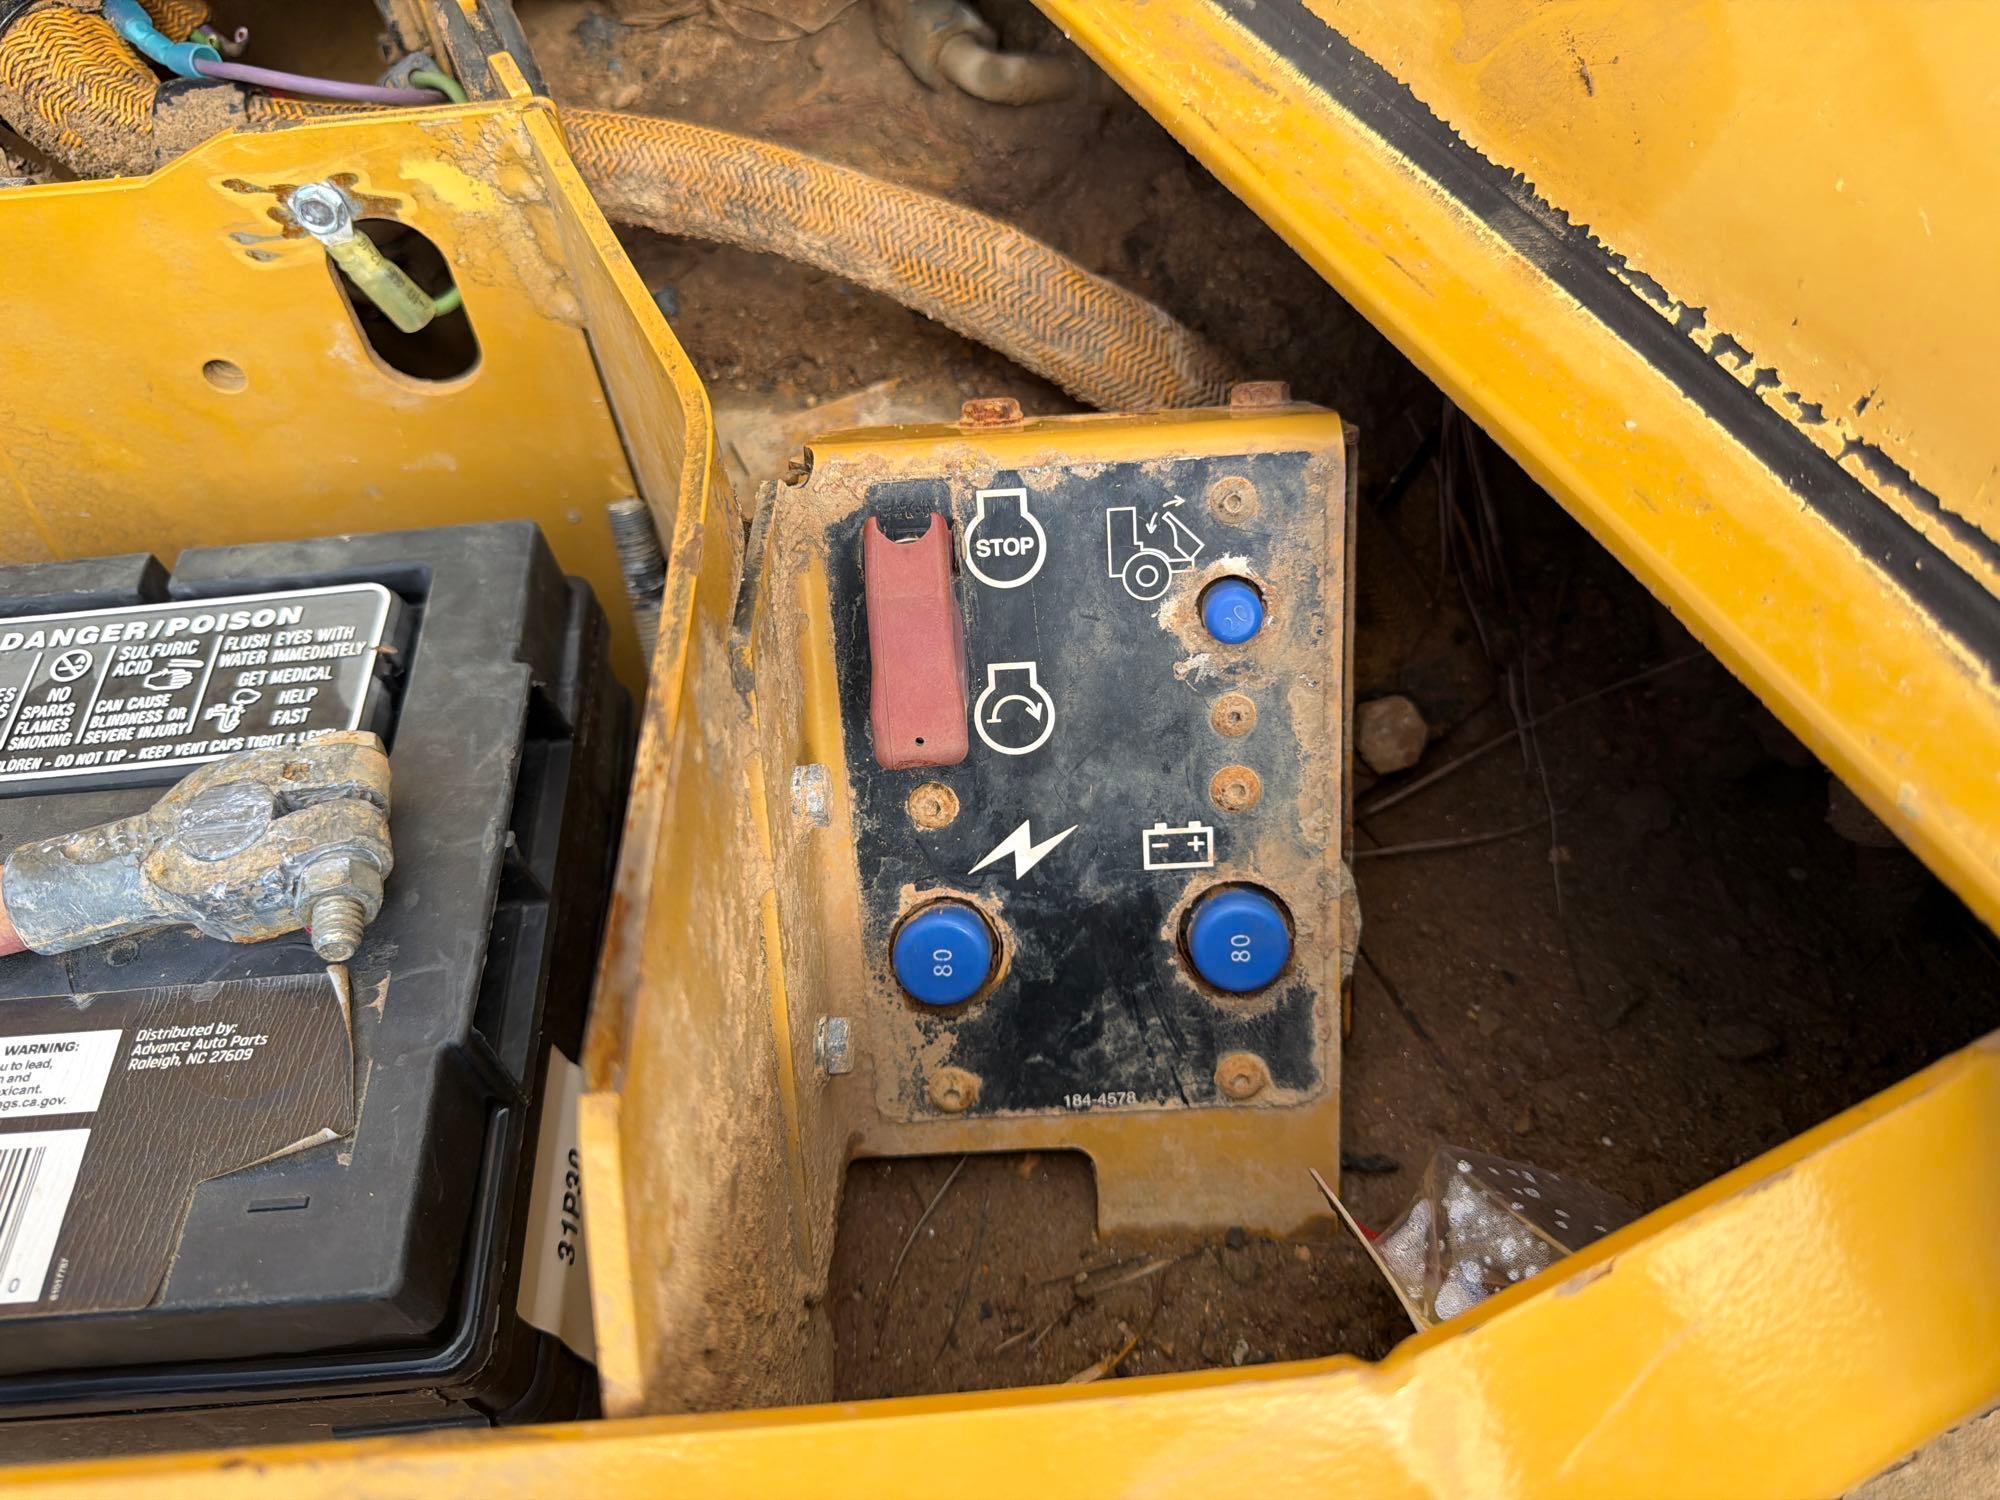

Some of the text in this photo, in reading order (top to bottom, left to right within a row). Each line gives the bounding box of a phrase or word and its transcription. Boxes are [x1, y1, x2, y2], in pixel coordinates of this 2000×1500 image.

[976, 536, 1034, 558] STOP
[0, 605, 304, 651] DANGER/POISON
[224, 626, 356, 650] FLUSH EYES WITH
[119, 640, 200, 660] SULFURIC
[218, 640, 367, 668] WATER IMMEDIATELY
[112, 660, 153, 677] ACID
[237, 665, 333, 687] GET MEDICAL
[46, 686, 72, 702] NO
[95, 693, 172, 713] CAN CAUSE
[277, 687, 318, 704] HELP
[20, 702, 76, 720] SPARKS
[89, 706, 187, 729] BLINDNESS OR
[271, 708, 311, 726] FAST
[14, 718, 70, 735] FLAMES
[82, 722, 188, 744] SEVERE INJURY
[7, 732, 73, 750] SMOKING
[54, 754, 74, 767] DO
[75, 751, 103, 765] NOT
[105, 749, 127, 764] TIP
[138, 745, 172, 760] KEEP
[175, 741, 208, 756] VENT
[209, 737, 245, 752] CAPS
[248, 733, 285, 748] TIGHT
[1231, 935, 1250, 962] 80
[933, 949, 952, 976] 80
[136, 1022, 238, 1041] Distributed by:
[5, 1041, 79, 1056] WARNING:
[131, 1034, 269, 1056] Advance Auto Parts
[11, 1061, 22, 1070] to
[25, 1058, 53, 1070] lead,
[128, 1048, 254, 1070] Raleigh, NC 27609
[6, 1071, 31, 1083] and
[1063, 1091, 1136, 1108] 184-4578
